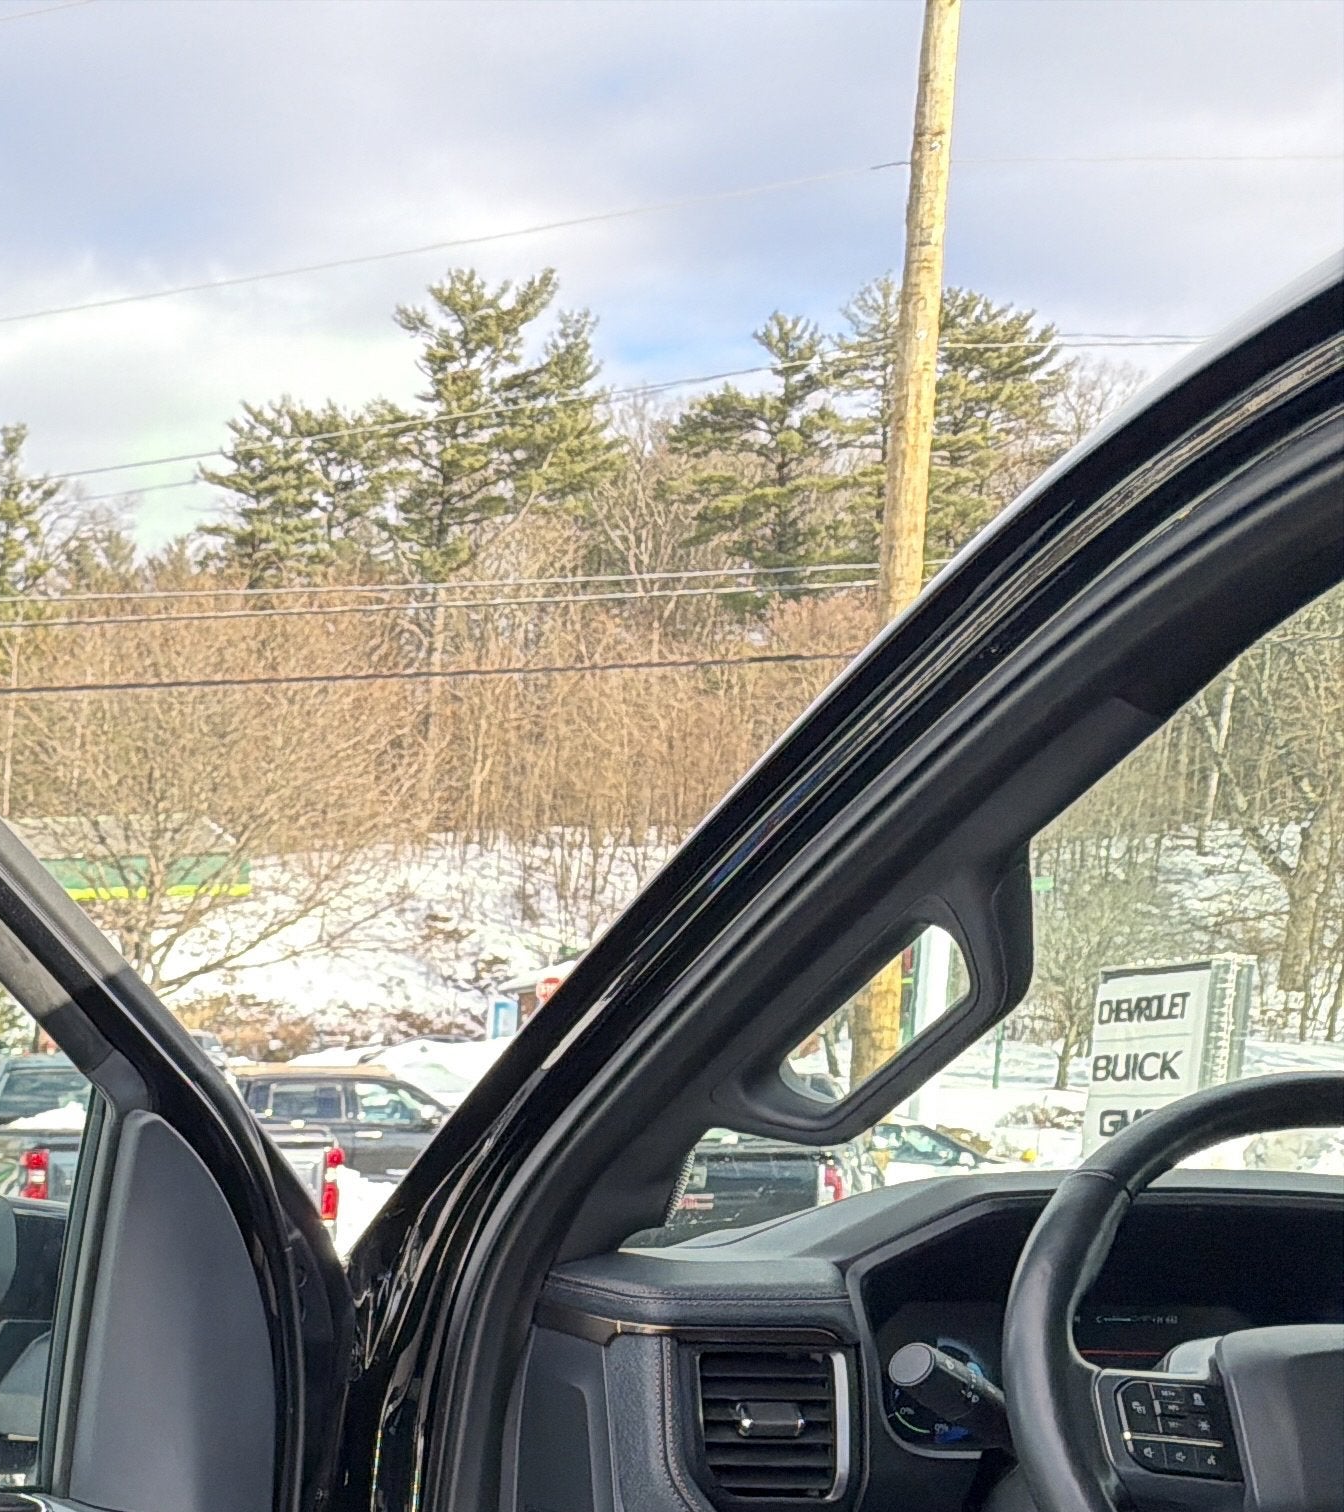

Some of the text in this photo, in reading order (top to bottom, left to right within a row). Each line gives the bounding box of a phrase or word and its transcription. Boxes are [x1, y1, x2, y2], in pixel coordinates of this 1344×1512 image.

[1098, 992, 1191, 1025] CHEVROLET
[1092, 1050, 1183, 1082] BUICK
[1099, 1109, 1158, 1137] GM
